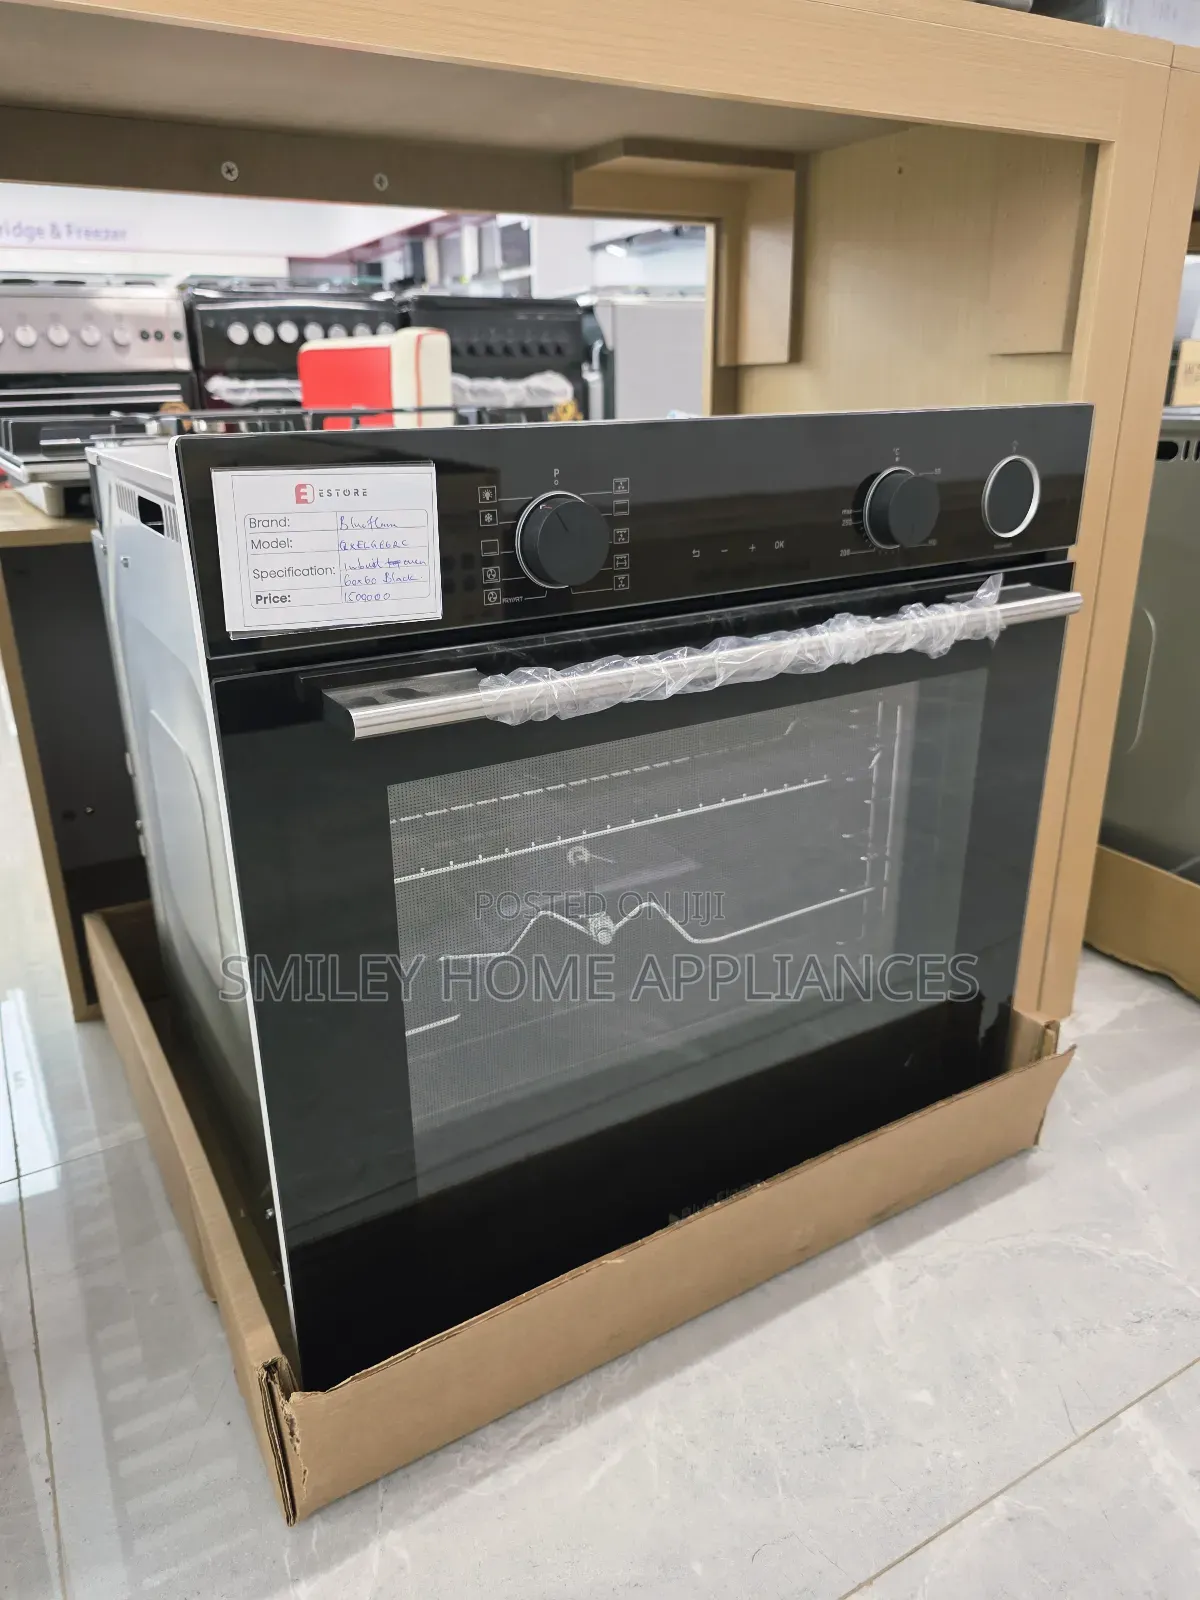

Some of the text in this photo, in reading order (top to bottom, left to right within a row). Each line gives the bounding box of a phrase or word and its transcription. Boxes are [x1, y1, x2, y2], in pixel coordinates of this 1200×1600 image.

[65, 222, 127, 241] Freezer
[553, 468, 560, 478] P
[319, 488, 368, 497] ESTORE
[249, 515, 290, 529] Brand:
[250, 538, 293, 550] Model:
[774, 540, 785, 550] OK
[252, 565, 336, 580] Specification:
[255, 593, 291, 605] Price:
